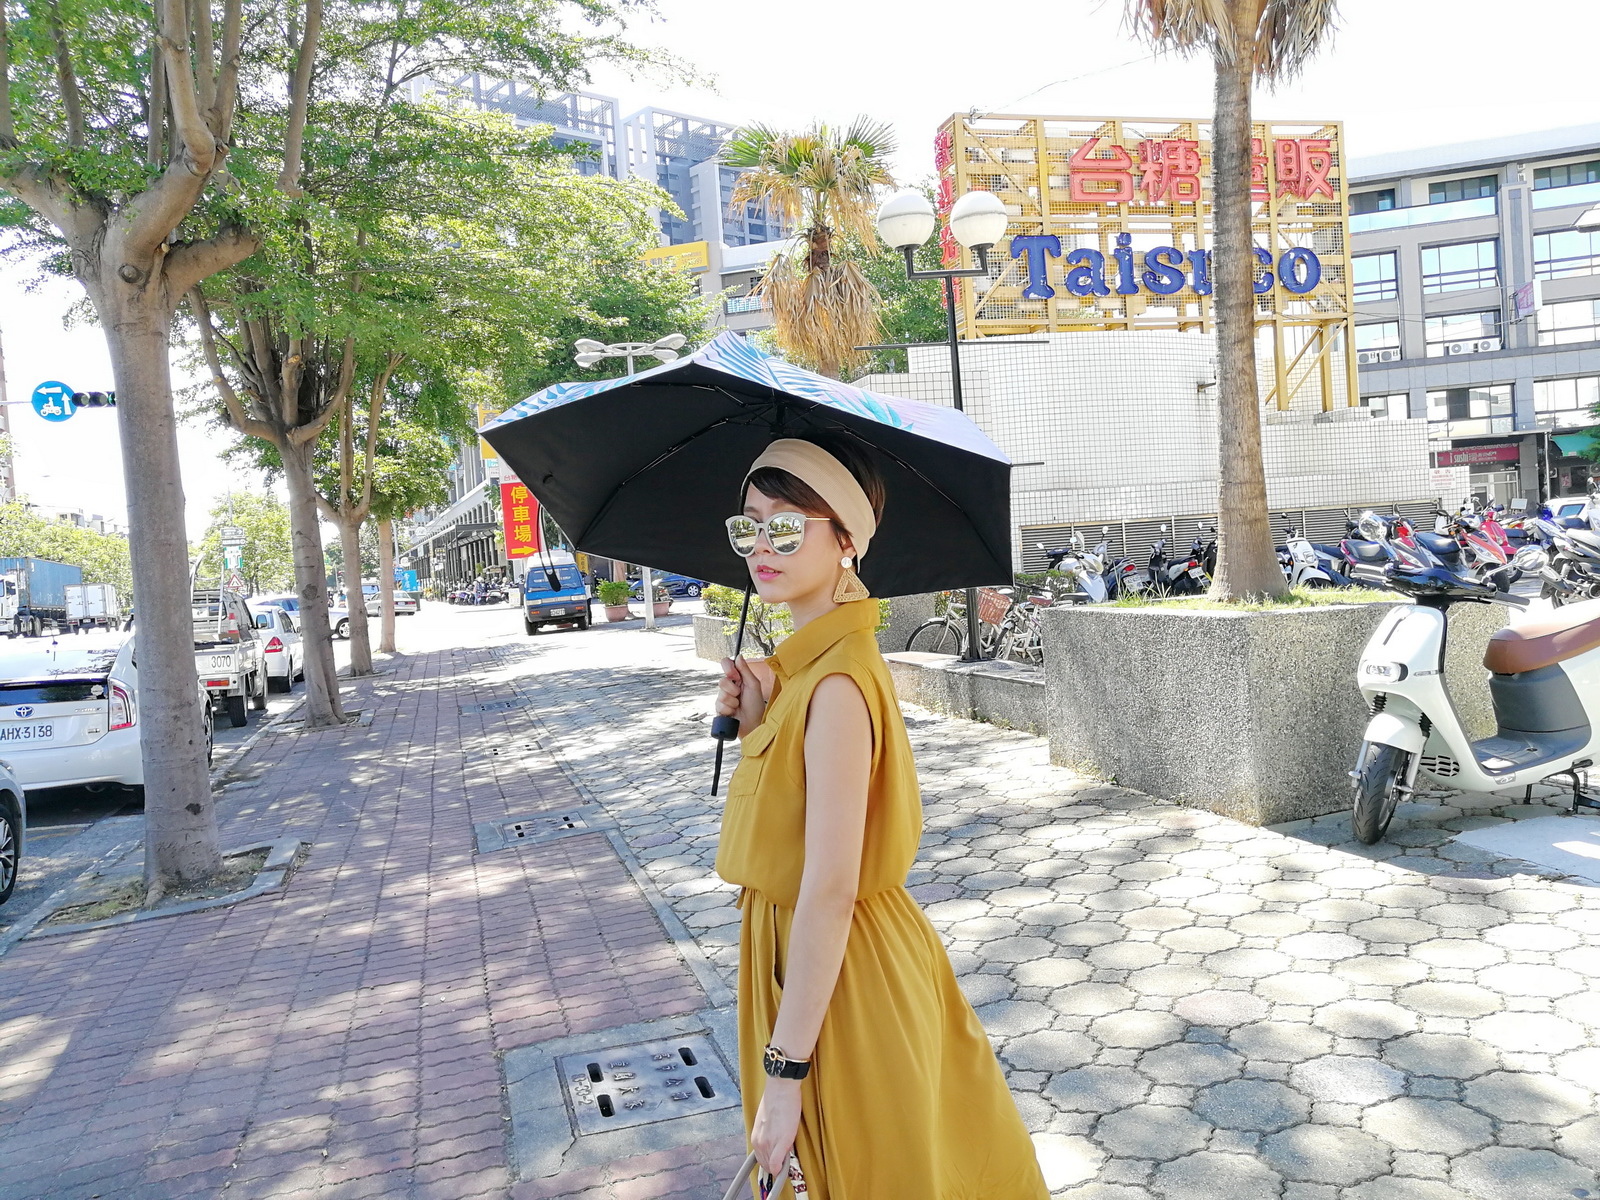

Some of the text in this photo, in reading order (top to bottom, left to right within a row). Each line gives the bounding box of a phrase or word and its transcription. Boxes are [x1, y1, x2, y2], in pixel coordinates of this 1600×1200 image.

[510, 485, 532, 543] 停車場
[211, 654, 232, 669] 3070
